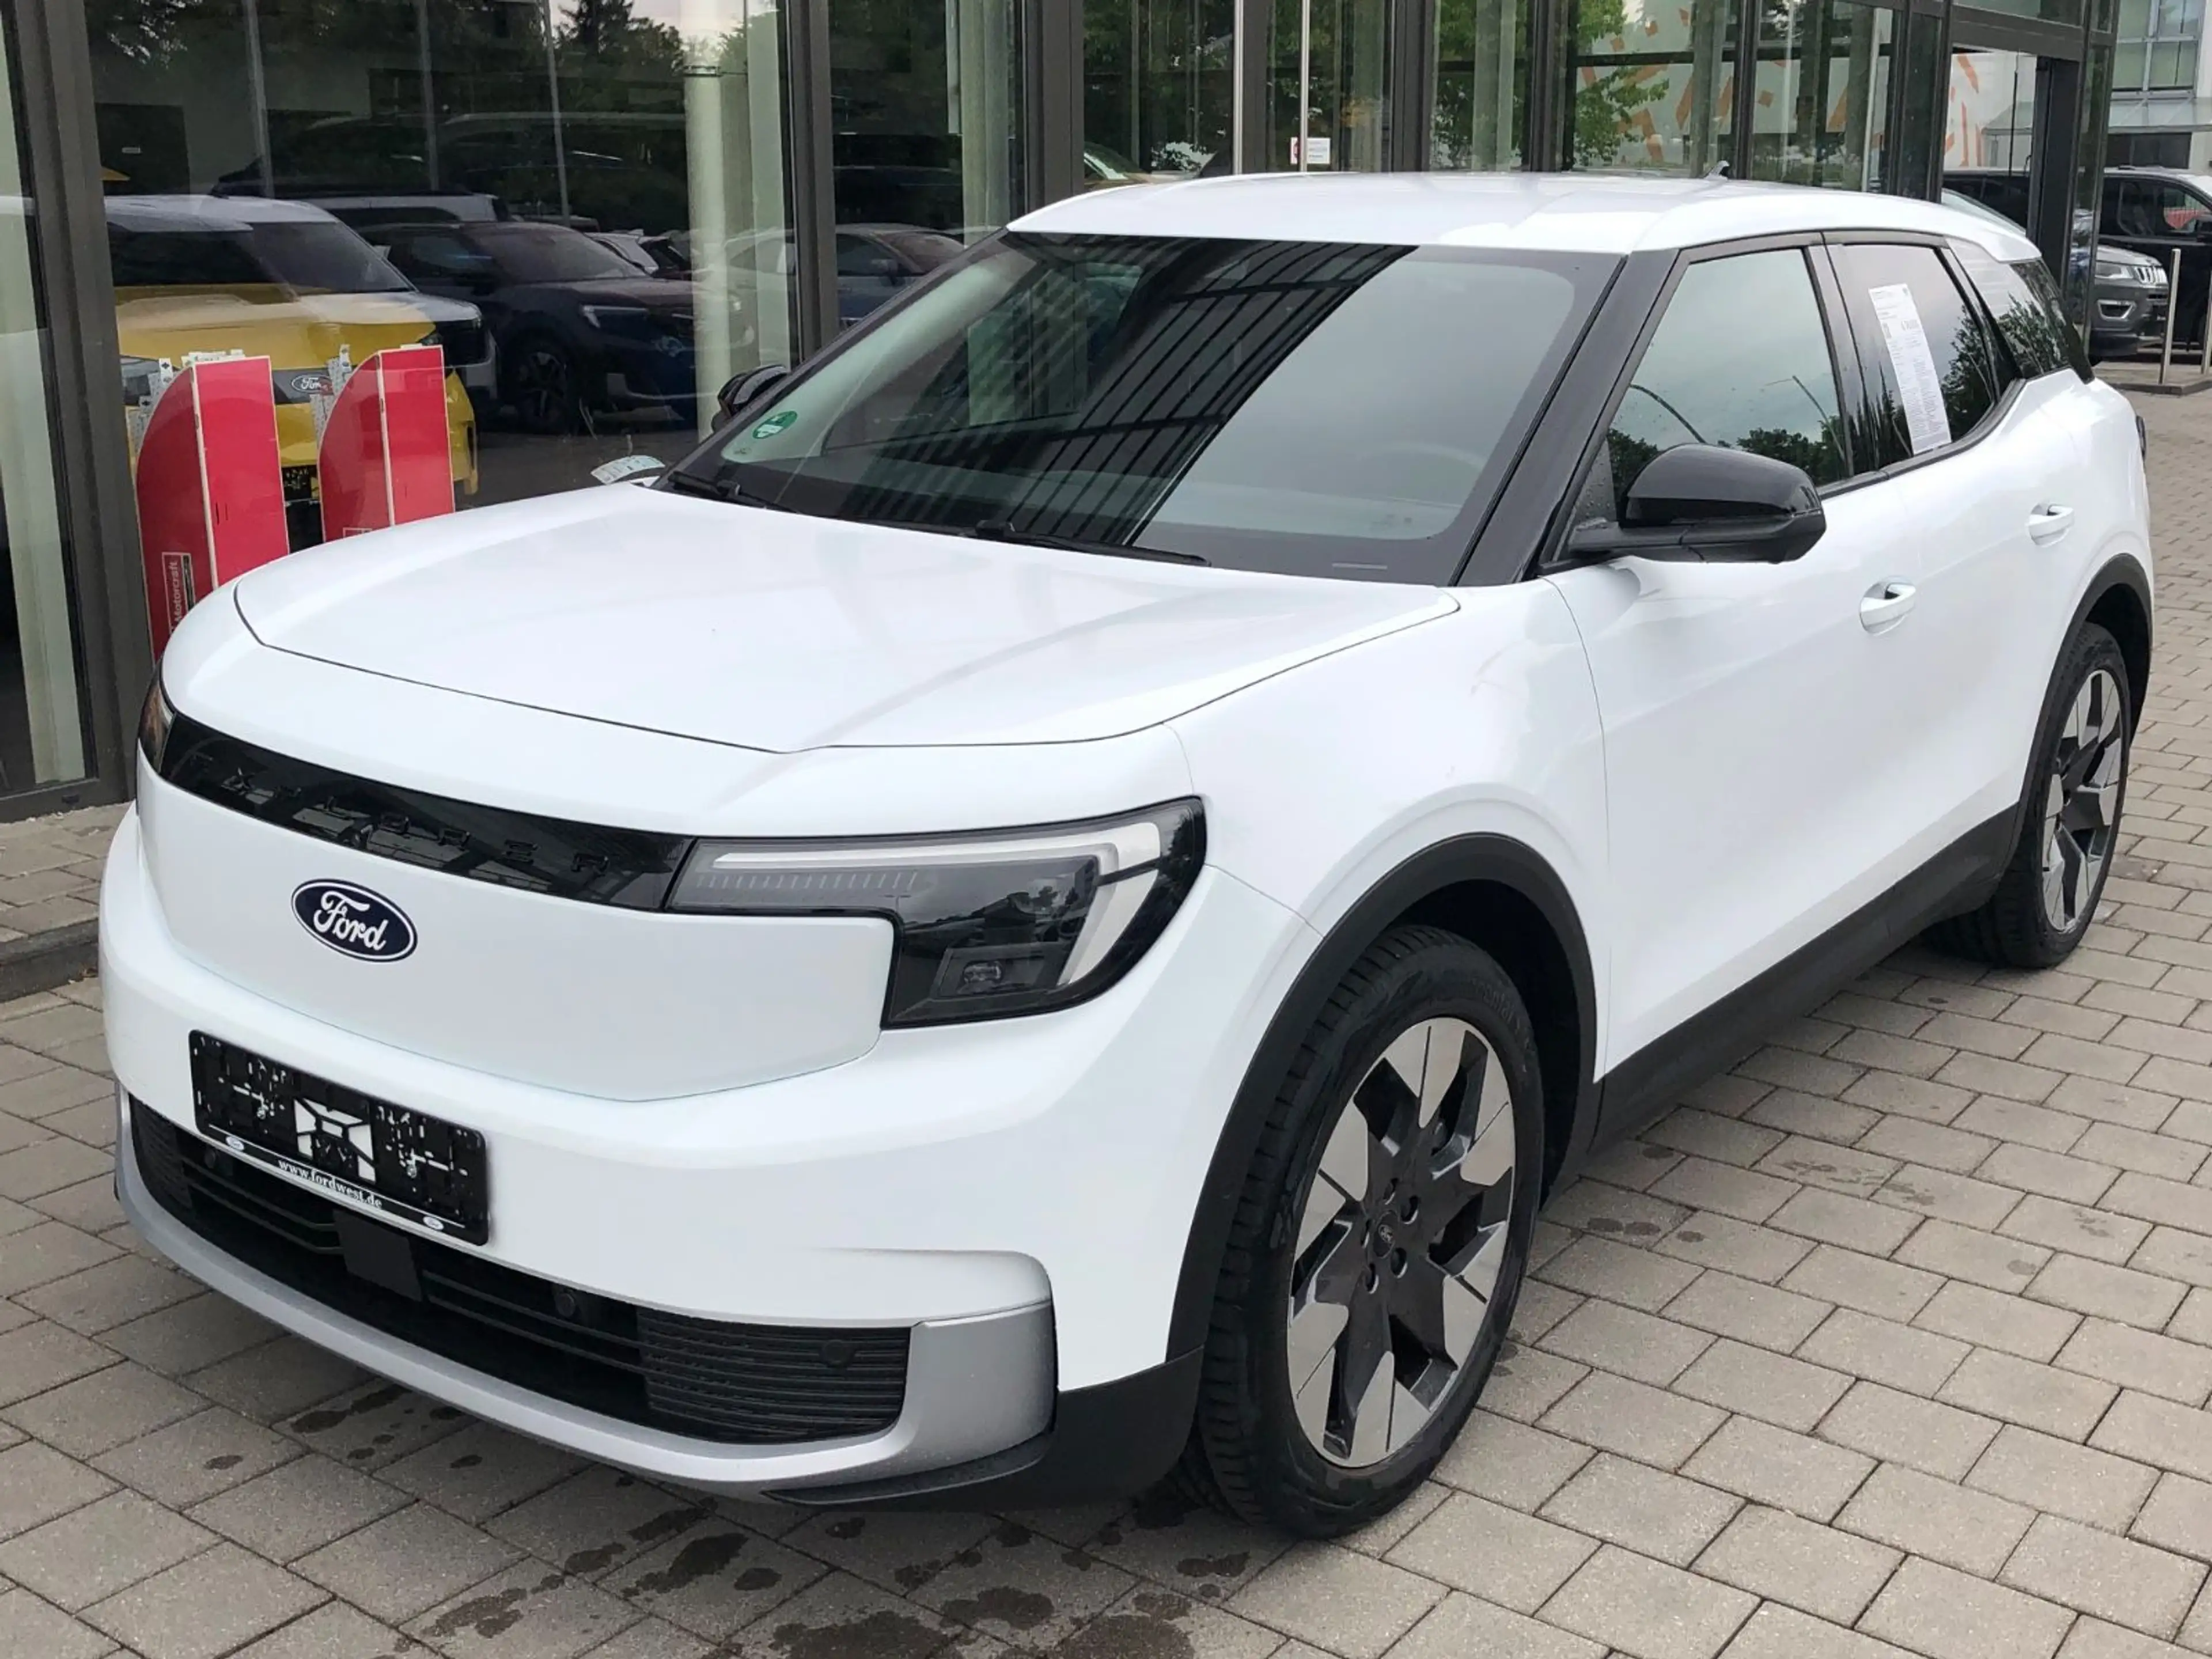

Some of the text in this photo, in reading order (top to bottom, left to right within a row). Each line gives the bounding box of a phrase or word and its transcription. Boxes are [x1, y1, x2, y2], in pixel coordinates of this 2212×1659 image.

[168, 561, 183, 622] Motorcraft
[313, 890, 389, 951] Ford
[278, 1159, 382, 1209] www.fordwest.de
